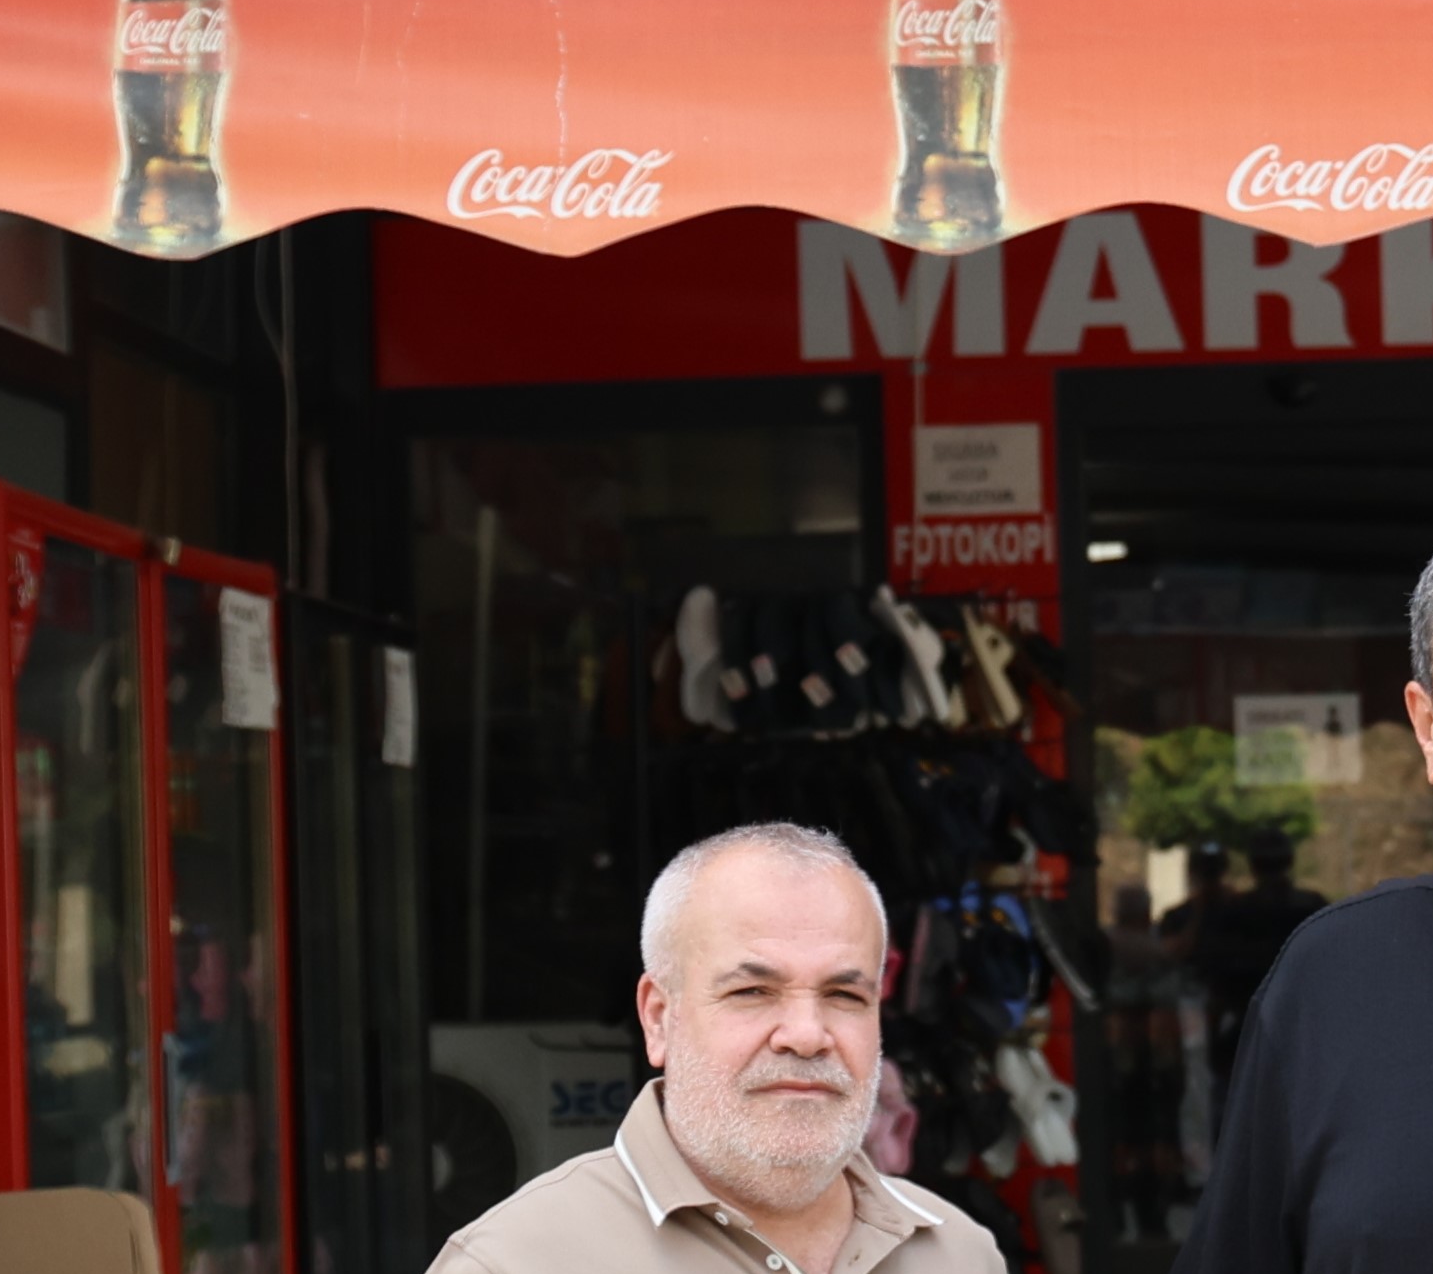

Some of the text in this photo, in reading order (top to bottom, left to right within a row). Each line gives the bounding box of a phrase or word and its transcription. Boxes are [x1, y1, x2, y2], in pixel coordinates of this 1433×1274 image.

[120, 7, 227, 55] Coca-Cola
[447, 148, 675, 219] Coca-Cola
[893, 515, 1054, 565] FOTOKOPİ
